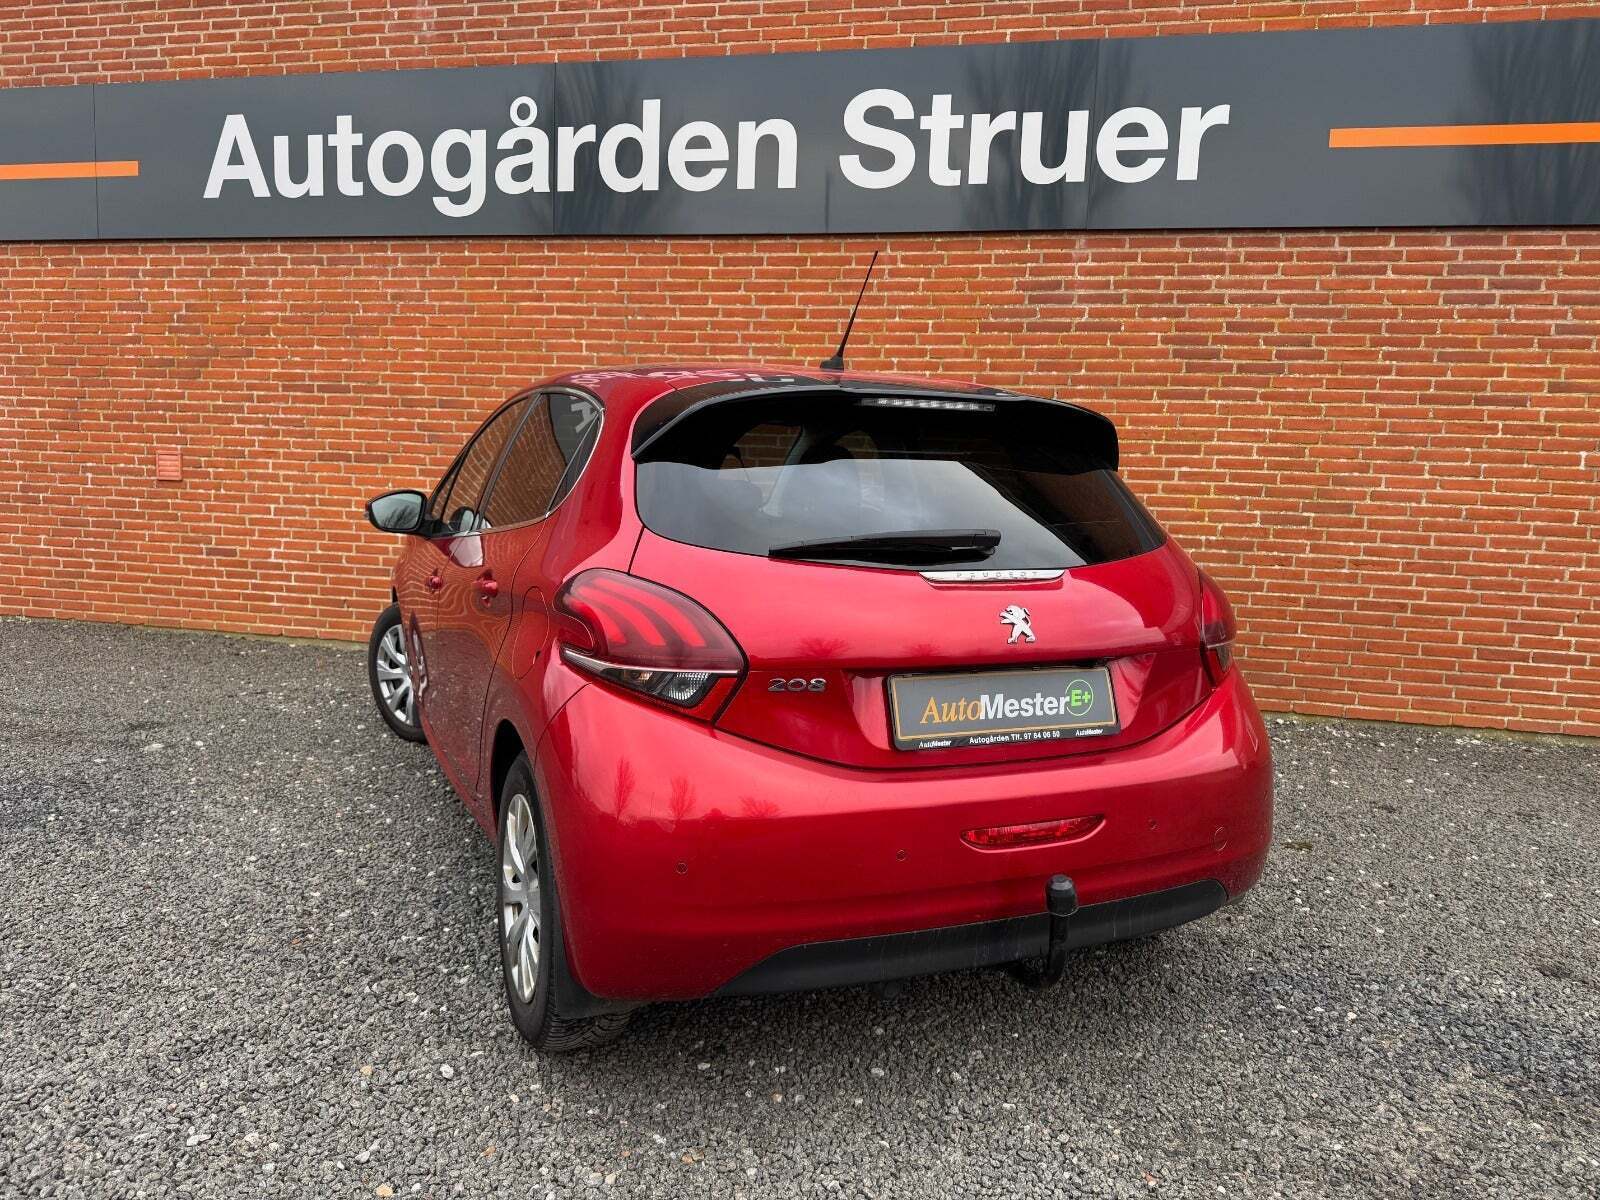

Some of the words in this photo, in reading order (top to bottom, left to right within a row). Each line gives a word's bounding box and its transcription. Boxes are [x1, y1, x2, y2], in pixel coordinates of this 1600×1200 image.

[203, 96, 797, 217] Autogården
[839, 88, 1231, 189] Struer
[768, 678, 827, 692] 208
[920, 692, 1070, 724] AutoMester
[969, 735, 1010, 744] Autogården
[1023, 732, 1032, 740] 97
